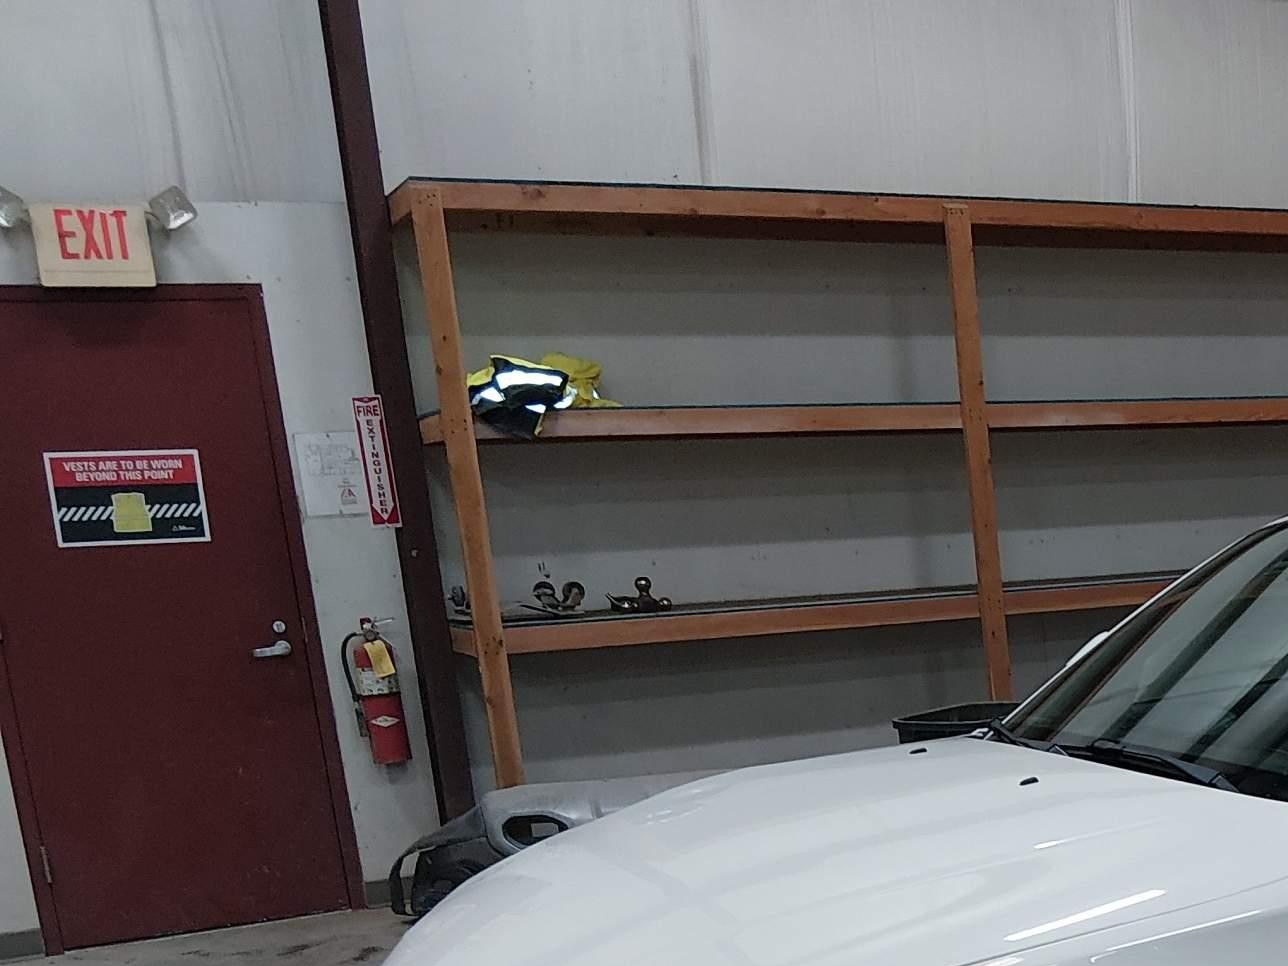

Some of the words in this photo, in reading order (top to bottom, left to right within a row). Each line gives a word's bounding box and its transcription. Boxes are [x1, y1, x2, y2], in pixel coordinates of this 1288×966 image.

[53, 208, 129, 260] EXIT
[356, 404, 380, 417] FIRE
[62, 461, 96, 472] VESTS
[98, 460, 119, 471] ARE
[121, 460, 134, 470] TO
[136, 460, 149, 470] BE
[150, 459, 183, 469] WORN
[365, 418, 389, 515] EXTINGUISHER
[75, 471, 117, 482] BEYOND
[119, 470, 142, 481] THIS
[144, 469, 174, 480] POINT
